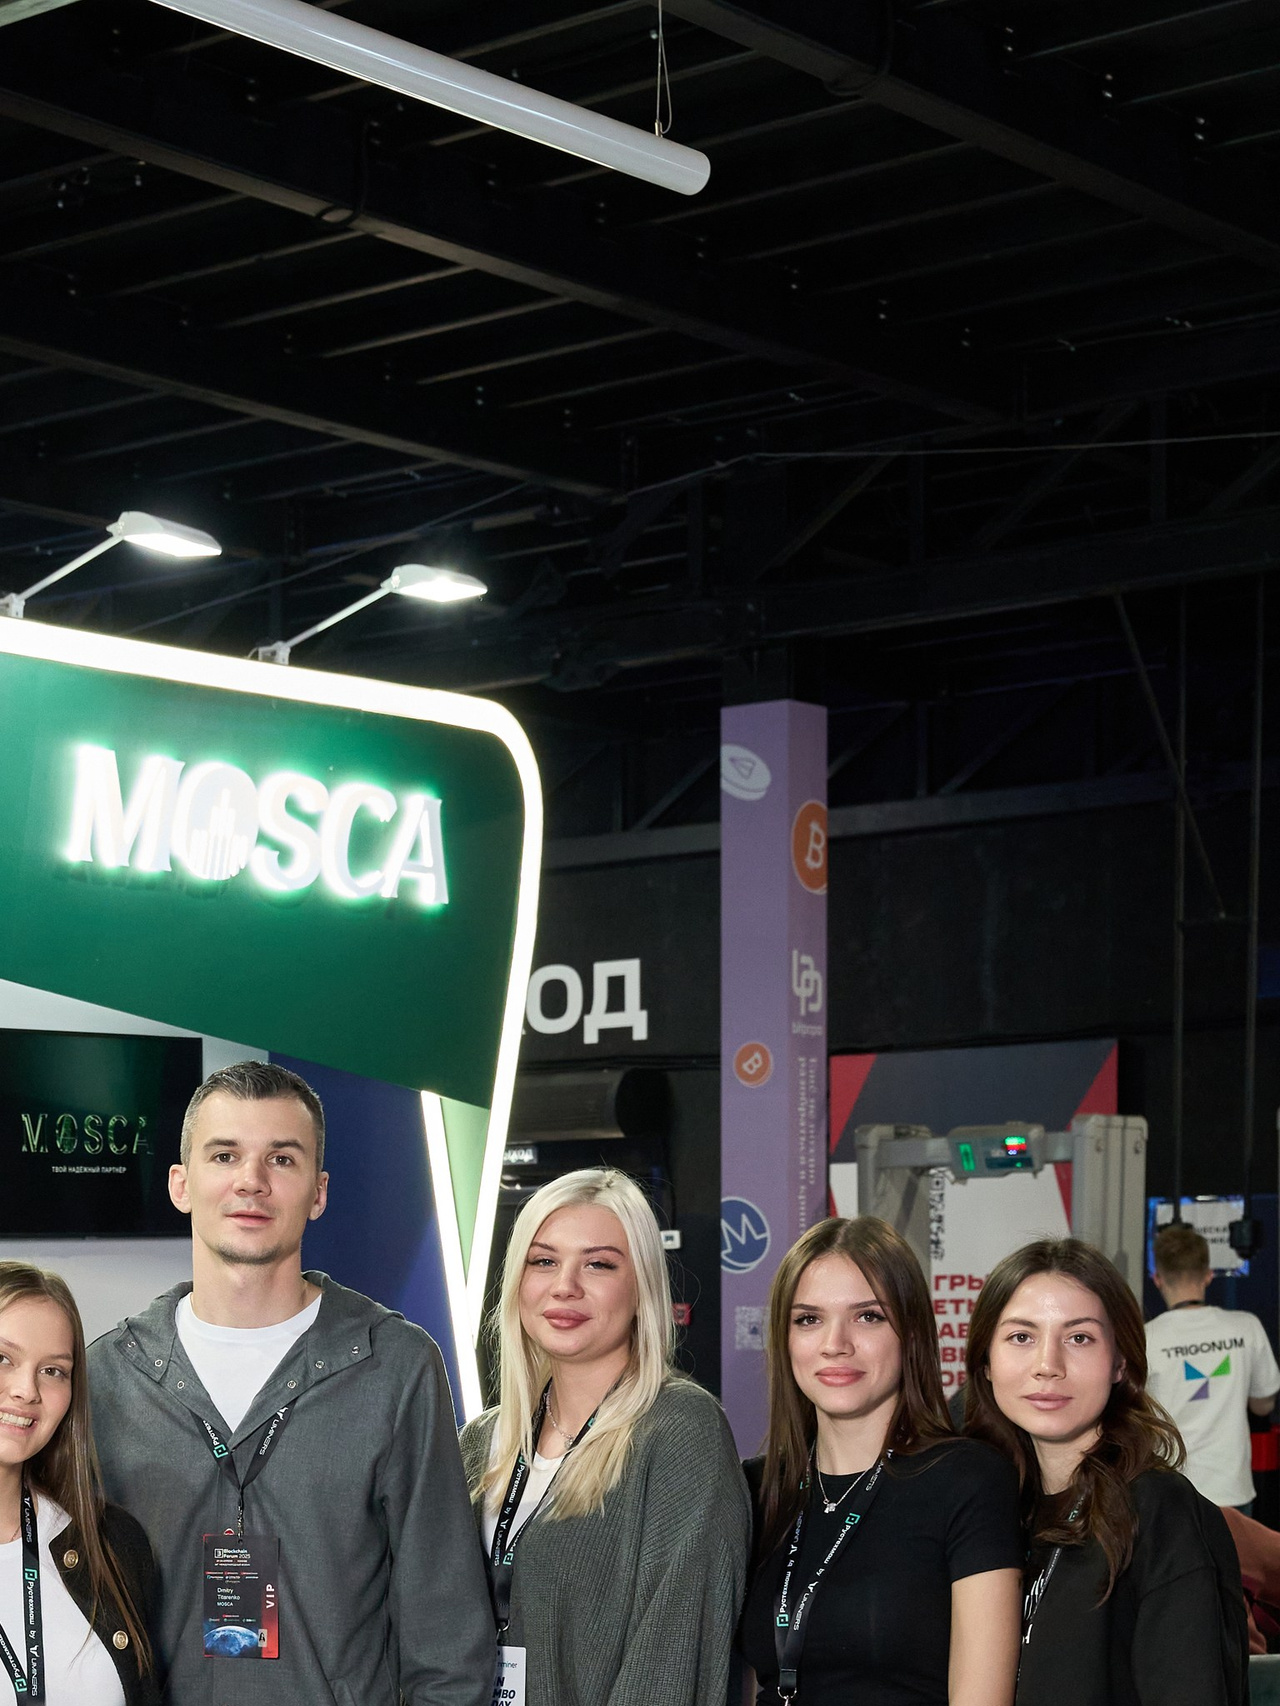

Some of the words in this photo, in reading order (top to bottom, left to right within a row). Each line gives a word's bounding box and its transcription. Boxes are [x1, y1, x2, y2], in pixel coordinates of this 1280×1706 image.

[65, 743, 449, 906] MOSCA
[521, 958, 648, 1044] ОД
[21, 1113, 154, 1155] MOSCA
[1162, 1337, 1245, 1359] TRIGONUM
[266, 1583, 275, 1609] VIP
[29, 1630, 36, 1640] by
[492, 1689, 516, 1699] MBO
